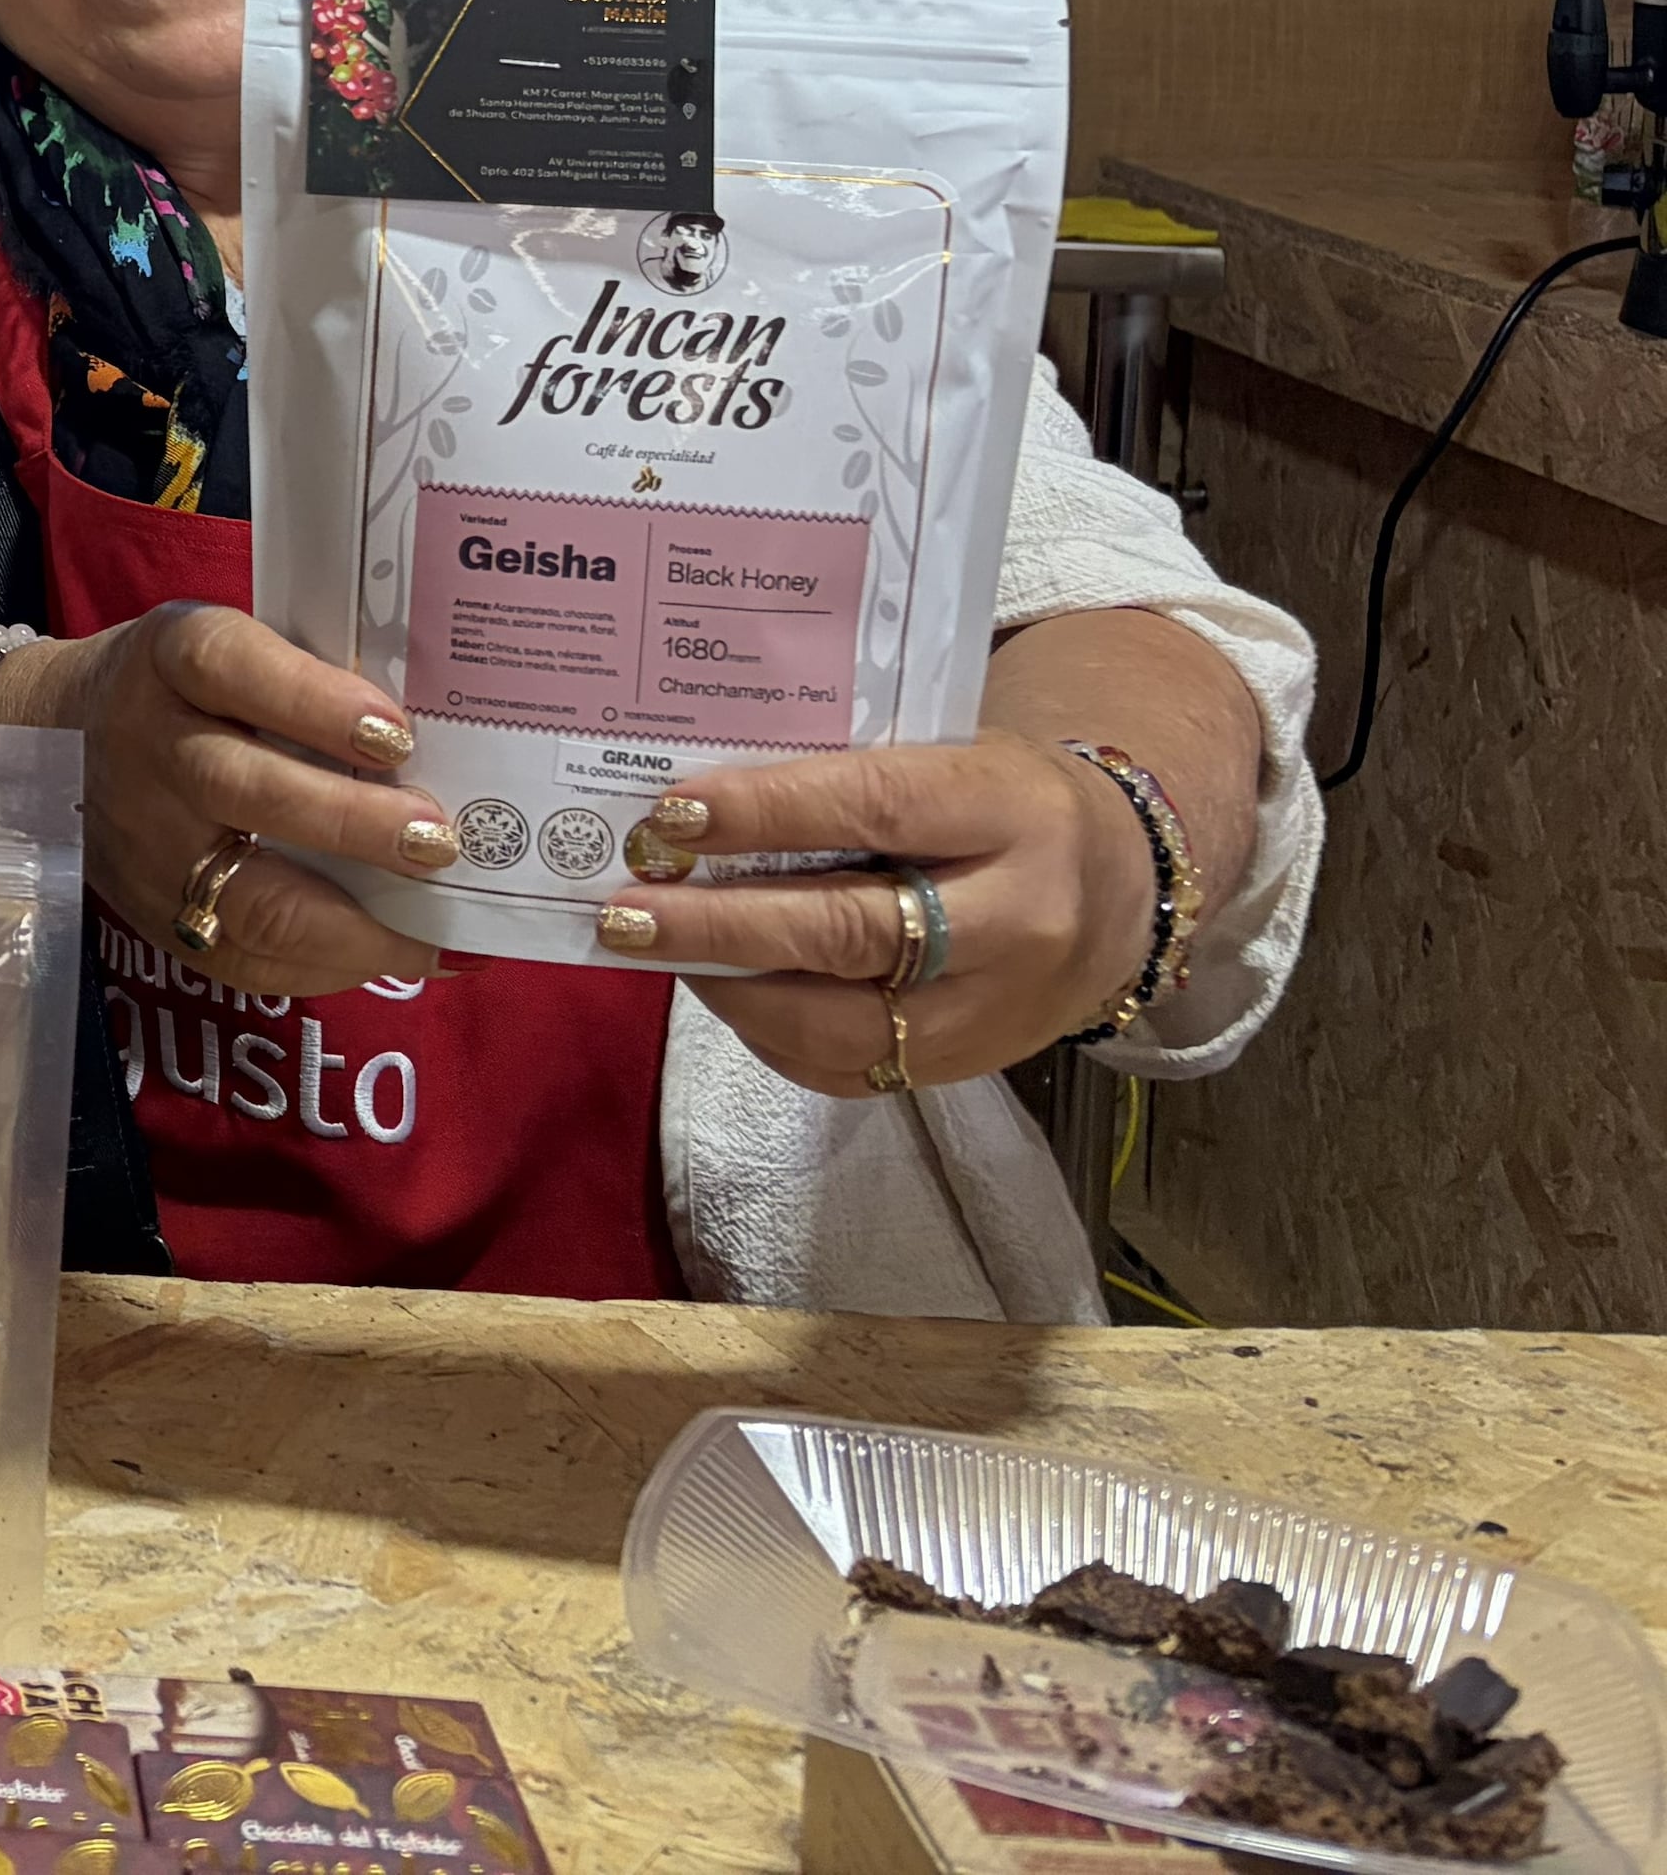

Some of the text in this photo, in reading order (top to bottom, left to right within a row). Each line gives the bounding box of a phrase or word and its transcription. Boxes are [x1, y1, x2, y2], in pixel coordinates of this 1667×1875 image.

[572, 279, 786, 368] Incan
[498, 333, 785, 431] forests
[585, 442, 716, 465] Café de especialidad
[460, 513, 507, 526] Variedad
[458, 535, 617, 582] Geisha
[668, 543, 712, 556] Proceso
[667, 561, 819, 597] Black Honey
[664, 617, 700, 629] Altitud
[658, 677, 785, 704] Chanchamayo
[798, 685, 837, 703] Perú
[602, 750, 673, 771] GRANO
